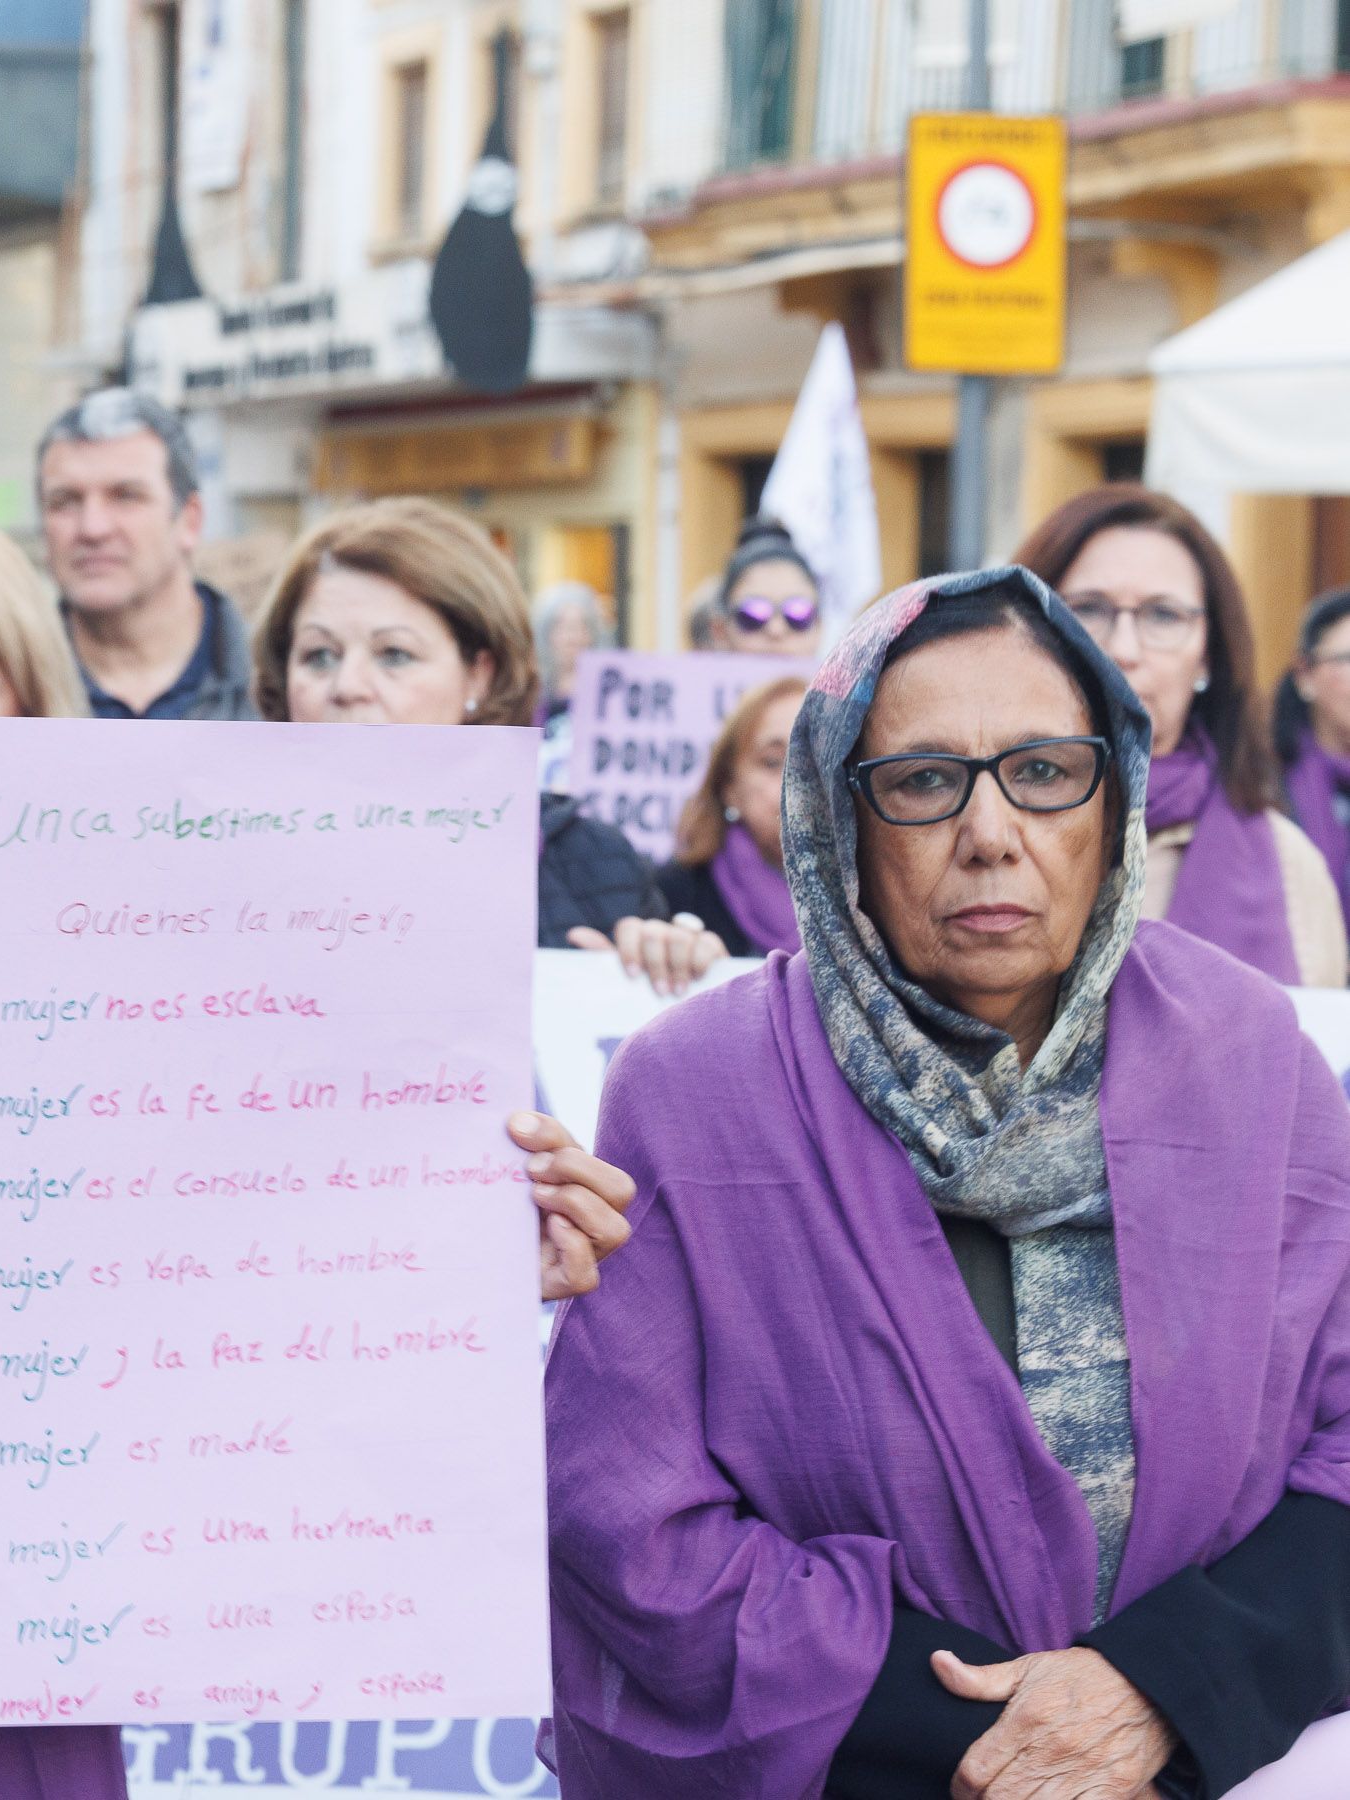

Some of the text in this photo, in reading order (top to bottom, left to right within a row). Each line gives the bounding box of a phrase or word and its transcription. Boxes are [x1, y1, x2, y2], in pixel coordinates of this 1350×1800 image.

[598, 667, 674, 720] POR
[314, 811, 340, 833] a
[354, 803, 416, 830] una
[234, 899, 271, 935] la
[0, 986, 101, 1041] mujer
[202, 982, 329, 1019] esclava
[88, 1090, 122, 1117] es
[137, 1081, 169, 1117] la
[185, 1081, 223, 1121] fe
[238, 1073, 279, 1114] de
[289, 1076, 339, 1112] un
[360, 1061, 490, 1114] hombre
[86, 1174, 116, 1202] es
[127, 1164, 159, 1200] el
[325, 1158, 360, 1193] de
[368, 1162, 409, 1190] un
[88, 1261, 123, 1289] es
[236, 1240, 277, 1278] de
[296, 1236, 429, 1275] hombre
[152, 1335, 187, 1371] la
[283, 1322, 336, 1363] del
[350, 1314, 490, 1364] hombre
[127, 1435, 163, 1464] es
[141, 1524, 177, 1557] es
[203, 1515, 272, 1547] una
[141, 1613, 175, 1640] es
[205, 1600, 275, 1632] una
[132, 1683, 164, 1710] es
